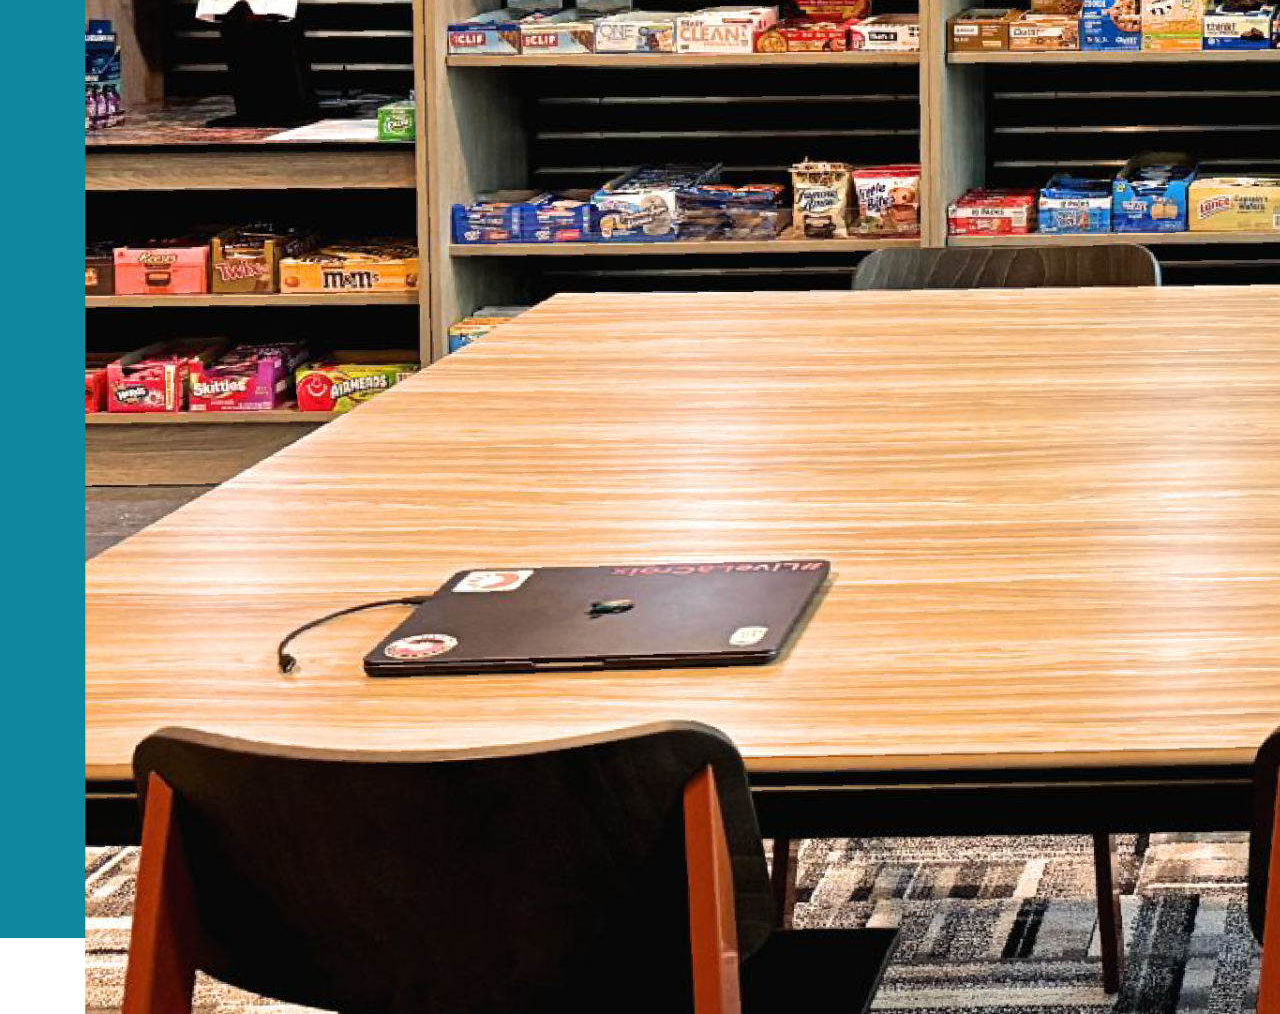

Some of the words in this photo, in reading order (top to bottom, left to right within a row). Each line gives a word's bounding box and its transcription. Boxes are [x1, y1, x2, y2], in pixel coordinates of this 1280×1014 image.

[458, 32, 484, 45] CLIF
[600, 23, 635, 39] ONE
[680, 25, 740, 42] CLEAN
[531, 33, 556, 46] CLIF
[193, 378, 247, 397] Skittles
